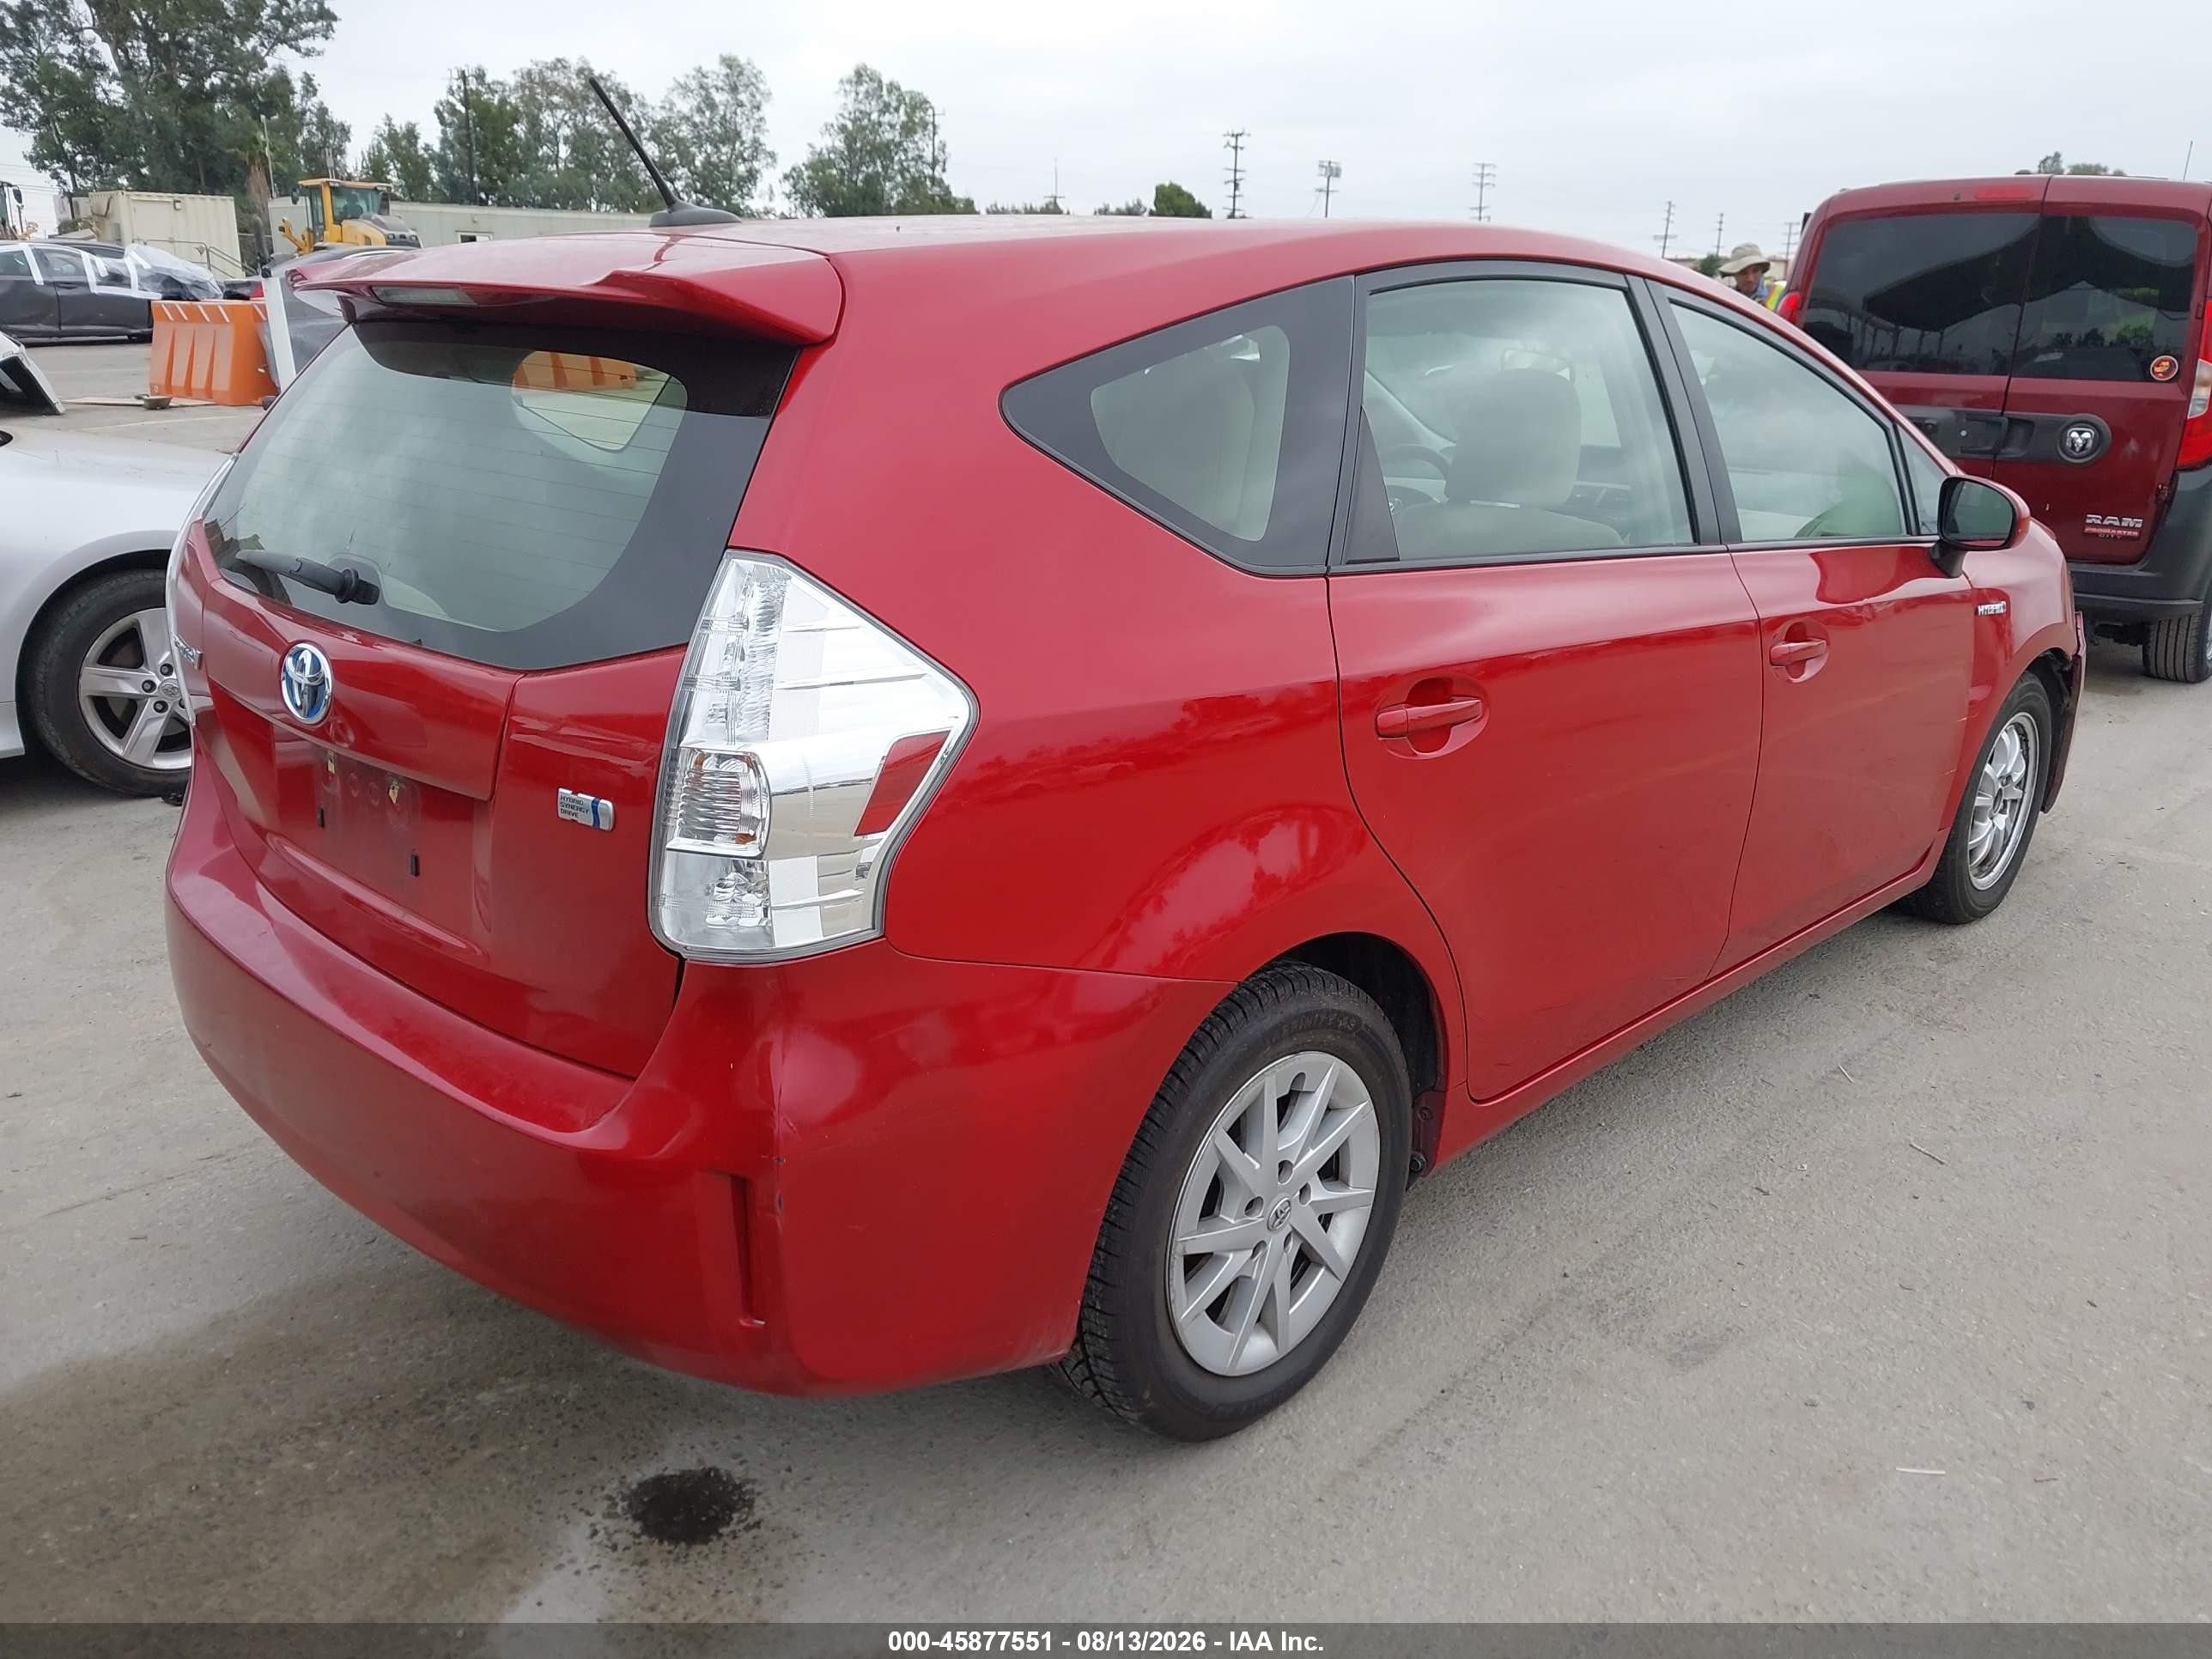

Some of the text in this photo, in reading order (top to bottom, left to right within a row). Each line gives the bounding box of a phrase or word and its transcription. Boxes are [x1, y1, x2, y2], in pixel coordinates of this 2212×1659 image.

[2085, 514, 2144, 529] RAM
[560, 795, 584, 806] HYBRID
[560, 801, 590, 814] SYNERGY
[560, 808, 579, 818] DRIVE
